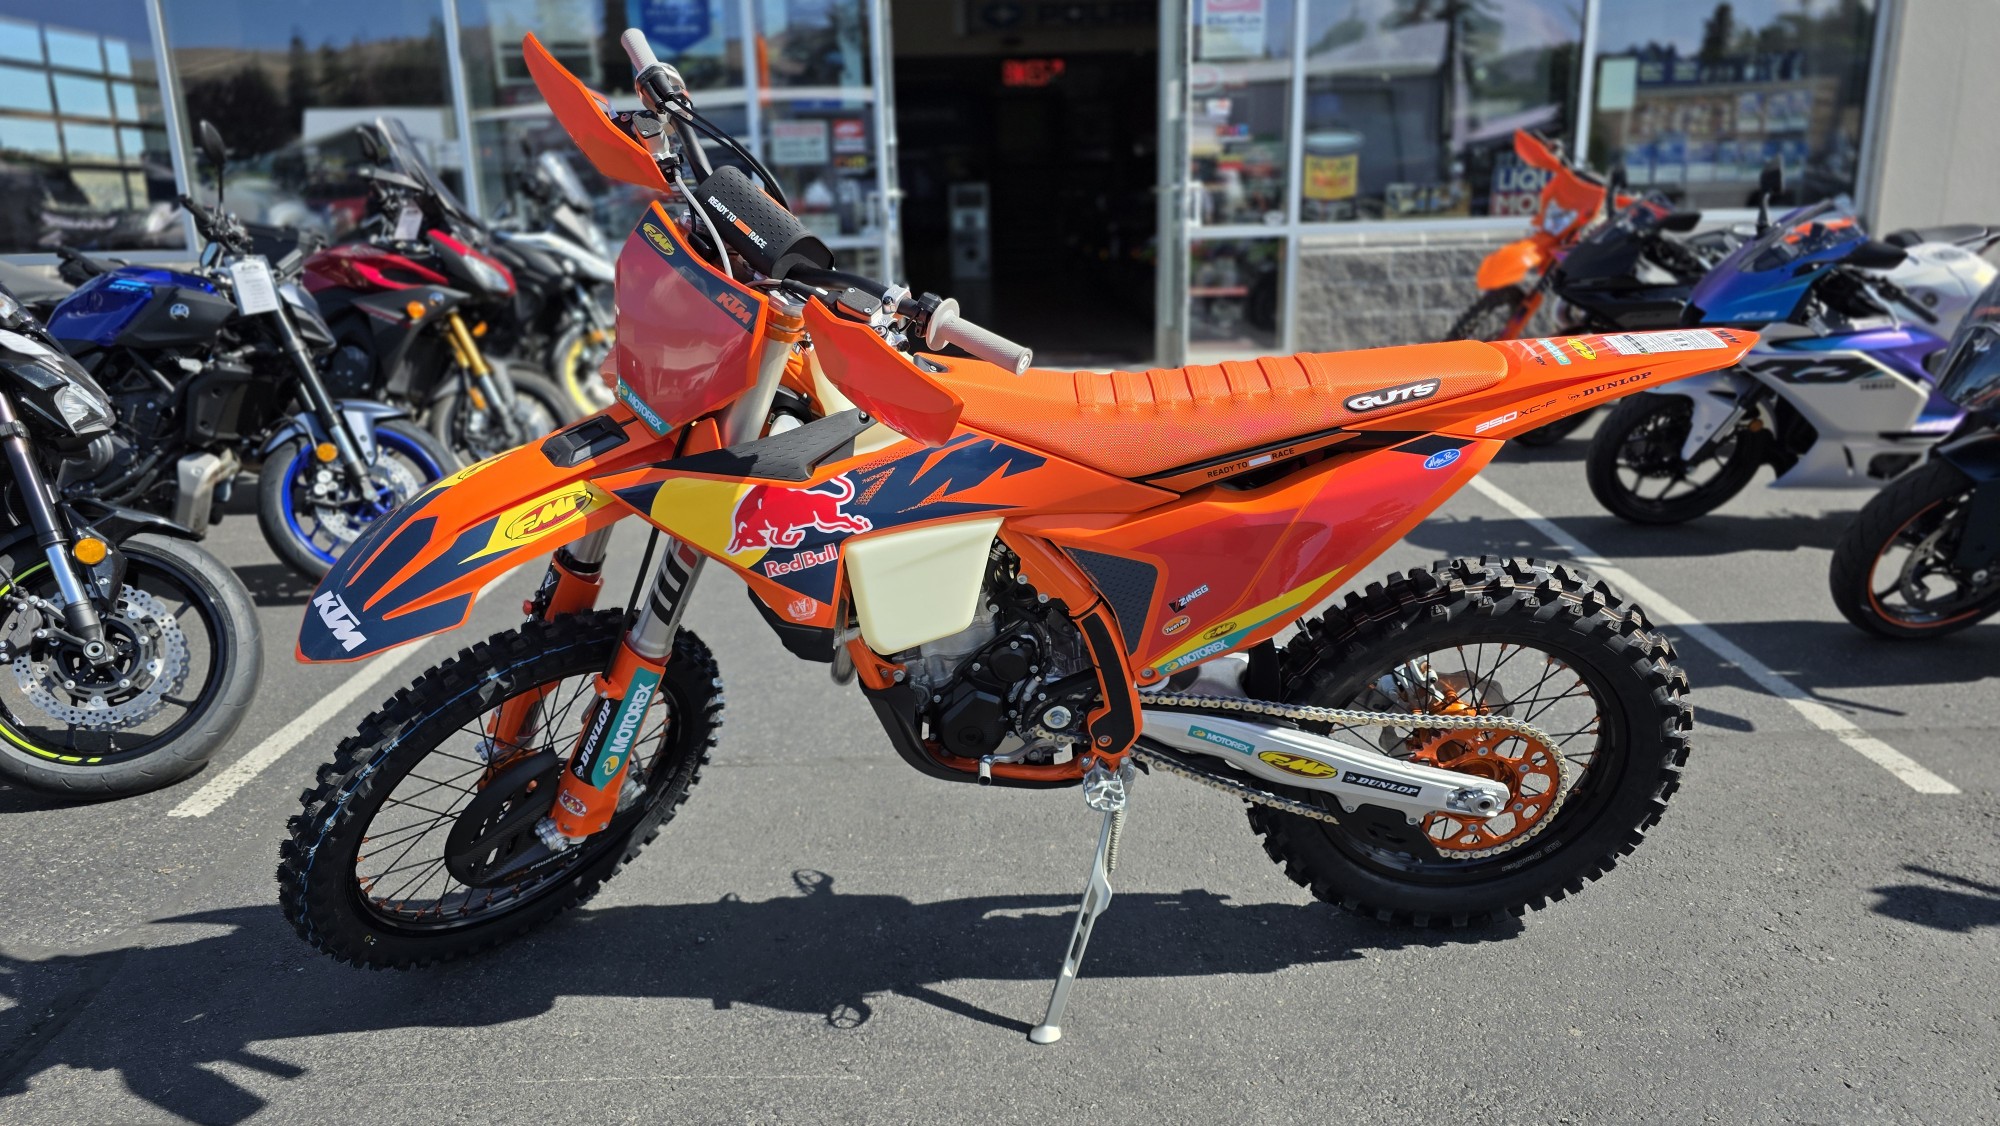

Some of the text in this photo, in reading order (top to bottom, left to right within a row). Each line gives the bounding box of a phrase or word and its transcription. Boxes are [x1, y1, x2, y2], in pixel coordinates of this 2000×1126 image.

[707, 195, 768, 250] READY TO RACE
[643, 223, 675, 255] FMF
[716, 292, 753, 324] KTM
[1347, 382, 1436, 411] GUTS
[1583, 371, 1653, 397] DUNLOP
[627, 392, 662, 431] MOTOREX
[1475, 398, 1558, 435] 350 XC-F
[1207, 447, 1295, 479] READY TO RACE
[509, 489, 591, 541] FMF
[764, 542, 838, 578] Red Bull
[1178, 583, 1210, 607] ZINGG
[312, 590, 367, 652] KTM
[1205, 622, 1236, 639] FMF
[1178, 640, 1230, 667] MOTOREX
[579, 699, 612, 767] DUNLOP
[609, 683, 656, 753] MOTOREX
[1206, 733, 1251, 753] MOTOREX
[1260, 752, 1338, 778] FMF
[1356, 776, 1420, 795] DUNLOP
[530, 844, 582, 871] POWERPARTS
